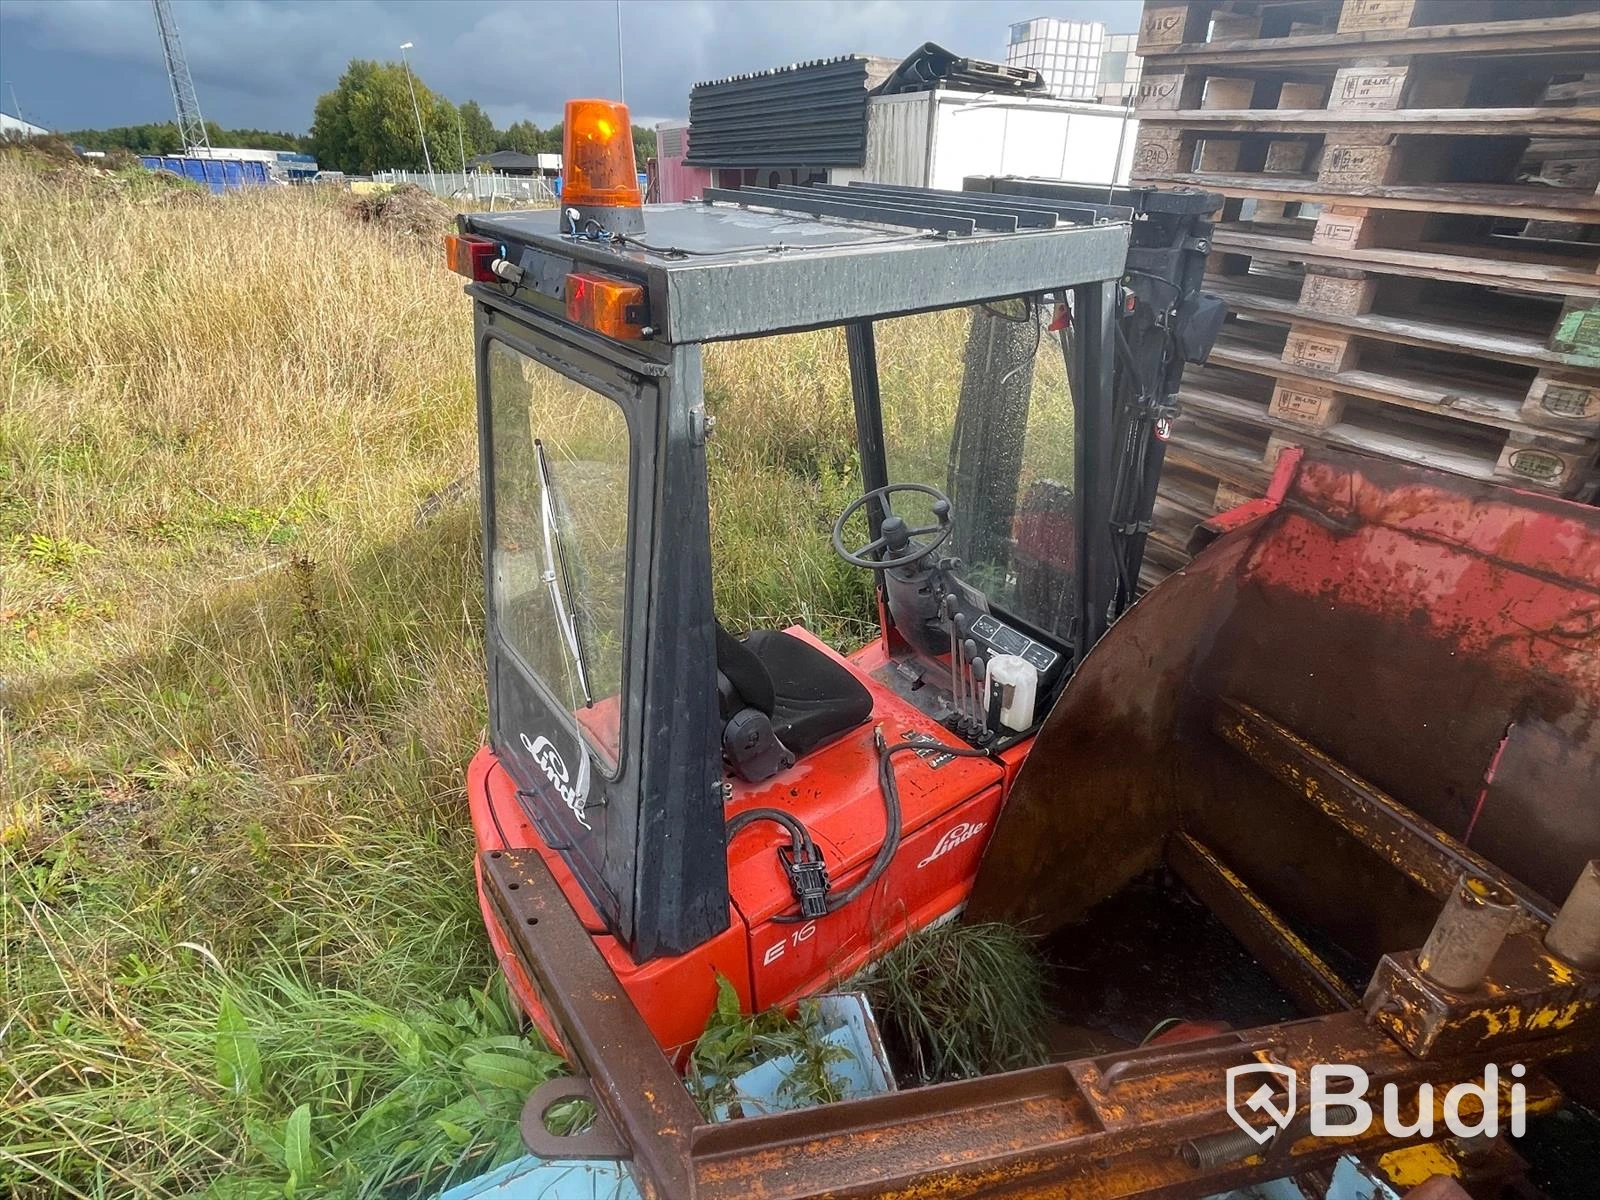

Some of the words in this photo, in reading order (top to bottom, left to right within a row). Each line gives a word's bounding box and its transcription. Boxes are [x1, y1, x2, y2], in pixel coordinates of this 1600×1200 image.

[520, 733, 592, 830] Lind
[917, 822, 988, 869] Linde
[763, 939, 787, 967] E
[791, 919, 817, 948] 16
